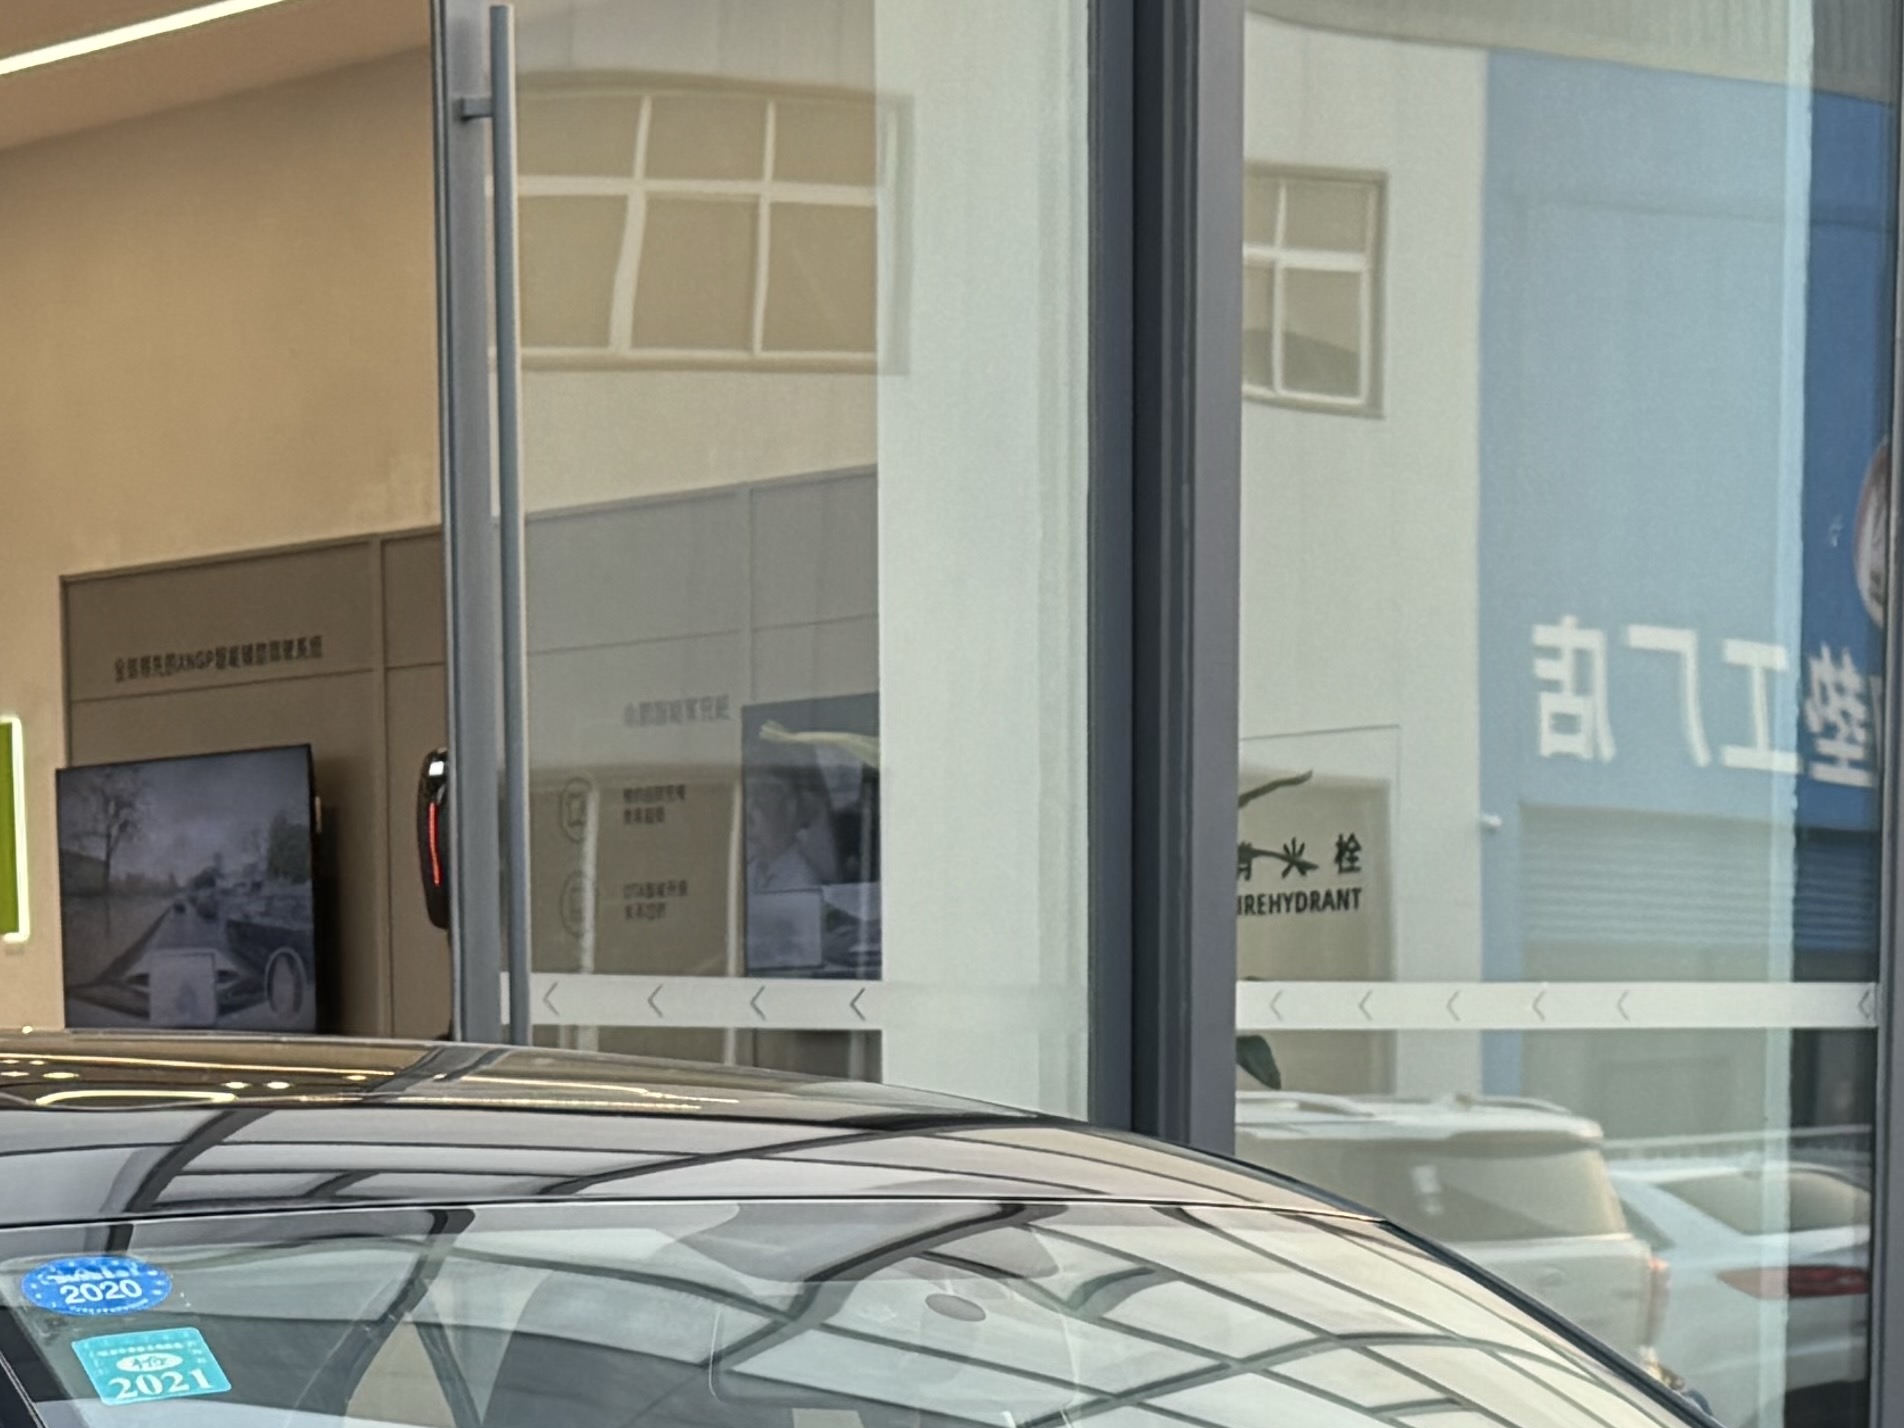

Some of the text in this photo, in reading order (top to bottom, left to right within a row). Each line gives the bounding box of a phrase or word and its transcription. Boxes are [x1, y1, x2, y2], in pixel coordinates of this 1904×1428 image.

[1237, 886, 1364, 915] IREHYDRANT
[59, 1277, 143, 1306] 2020
[108, 1366, 214, 1401] 2021
